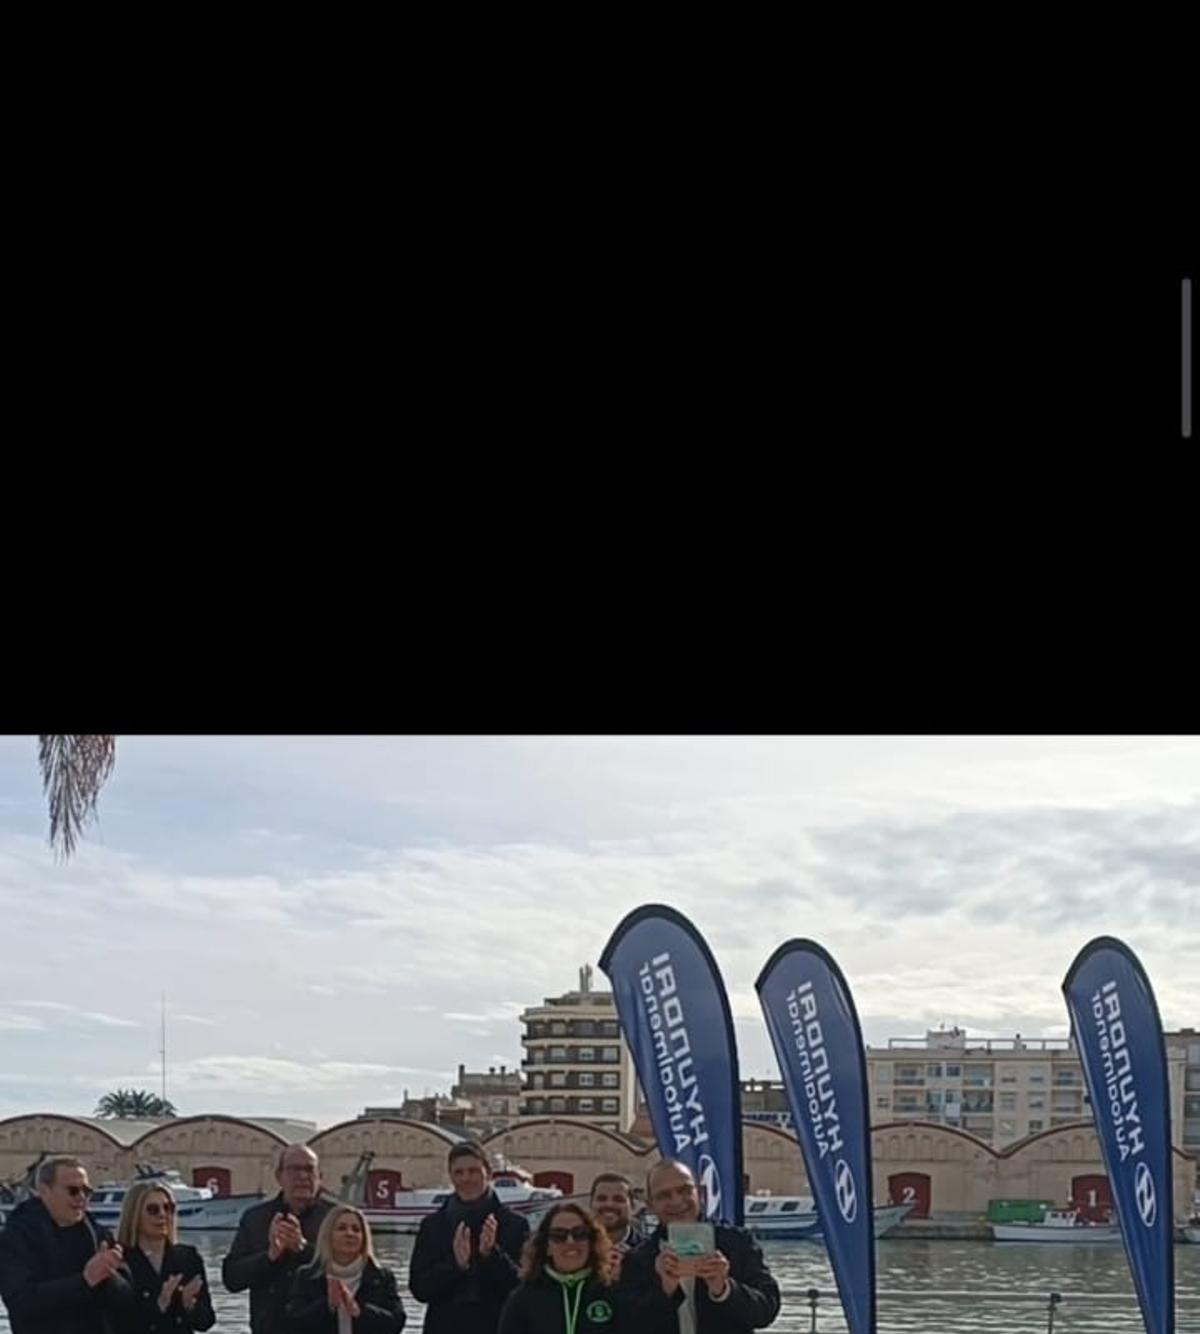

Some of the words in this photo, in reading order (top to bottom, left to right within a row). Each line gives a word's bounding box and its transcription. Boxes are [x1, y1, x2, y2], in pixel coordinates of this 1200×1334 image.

[206, 1177, 219, 1195] 6
[376, 1180, 389, 1199] 5
[902, 1186, 918, 1204] 2
[1087, 1189, 1097, 1208] 1
